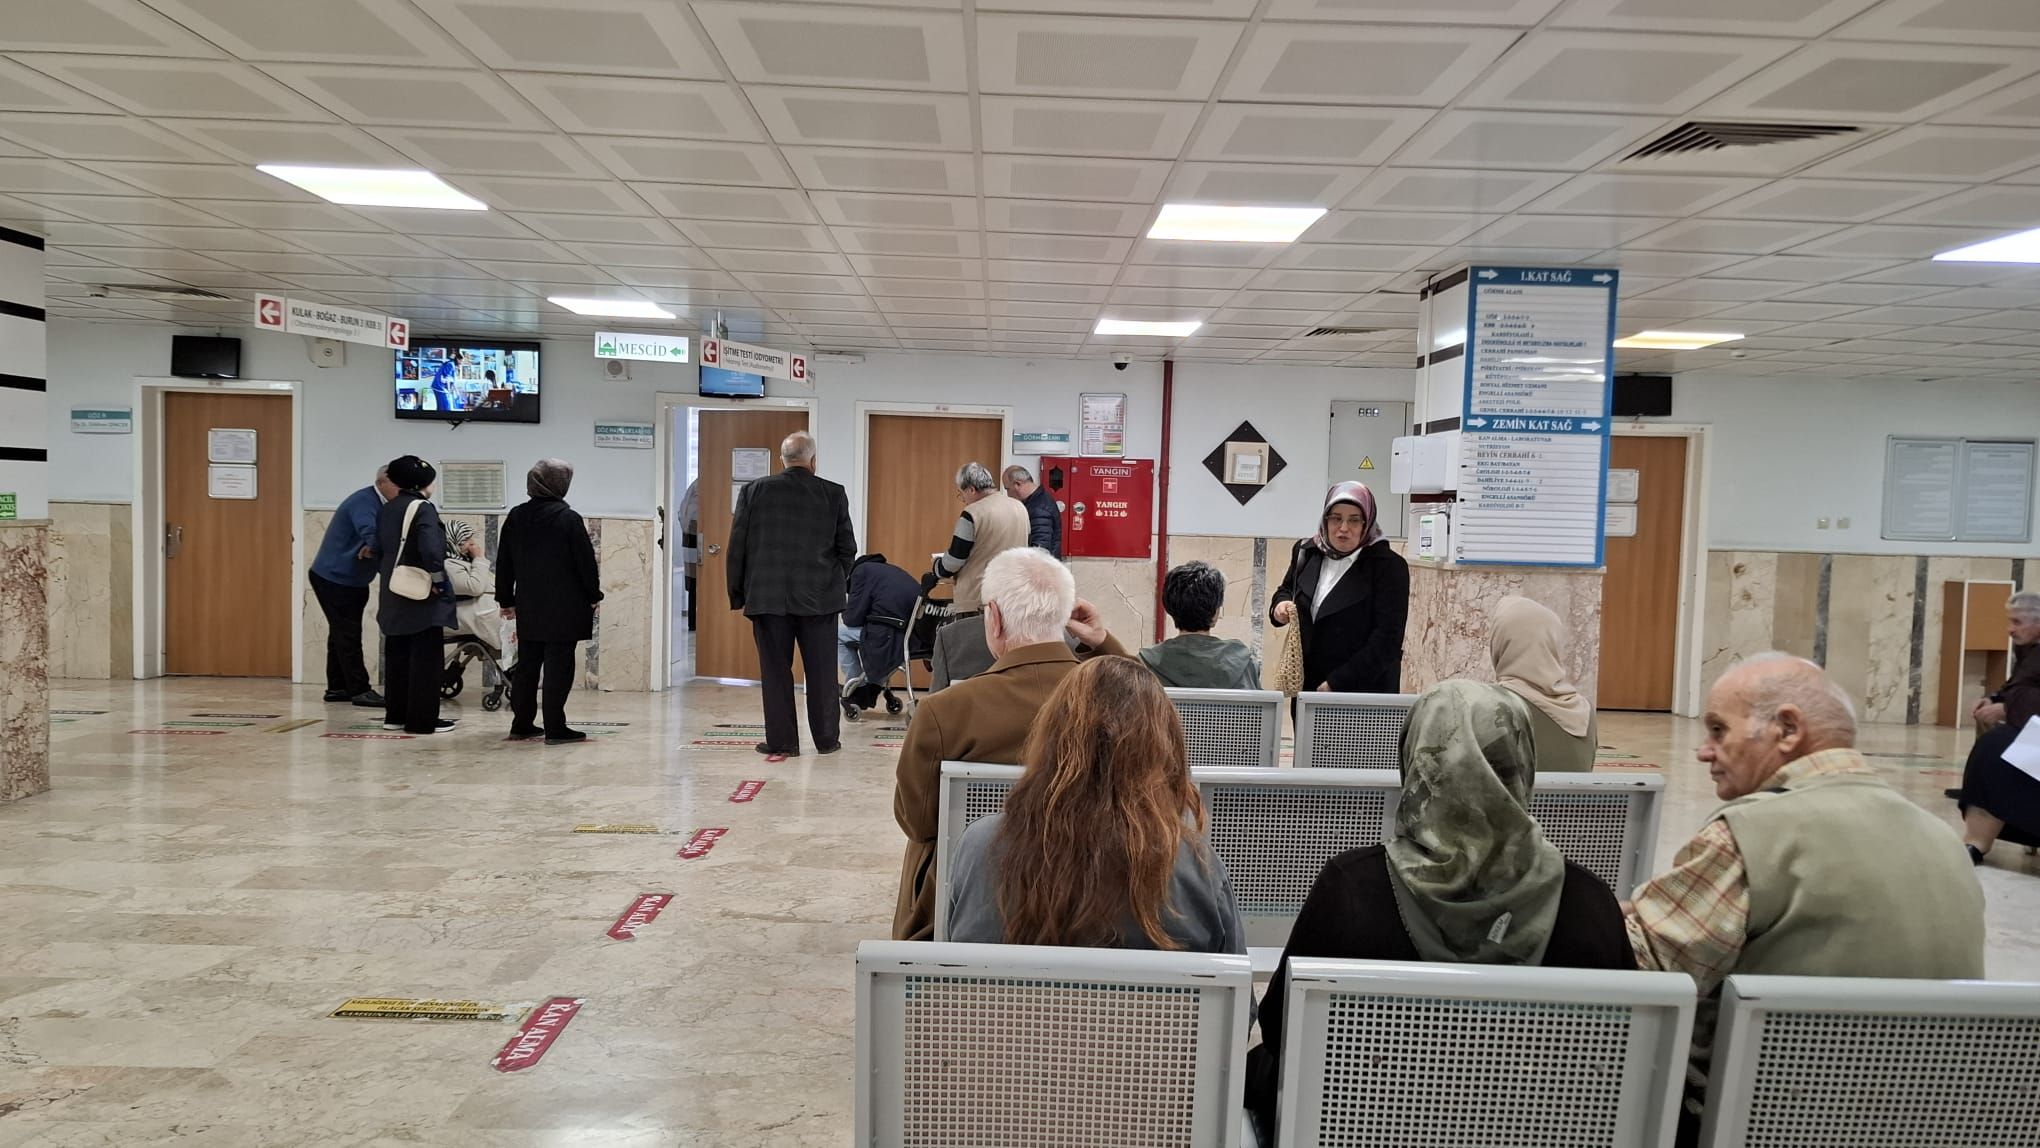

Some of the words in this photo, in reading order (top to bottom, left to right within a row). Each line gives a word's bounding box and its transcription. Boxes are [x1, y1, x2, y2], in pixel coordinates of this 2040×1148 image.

[1550, 270, 1572, 282] SAĞ
[292, 307, 312, 318] KULAK
[316, 311, 336, 322] BOĞAZ
[340, 316, 360, 326] BURUN
[618, 342, 666, 356] MESCİD
[723, 344, 739, 357] İŞİTME
[1492, 418, 1526, 429] ZEMİN
[1528, 420, 1550, 430] KAT
[1551, 419, 1572, 431] SAĞ
[534, 1003, 572, 1026] KAN
[505, 1027, 550, 1060] ALMA
